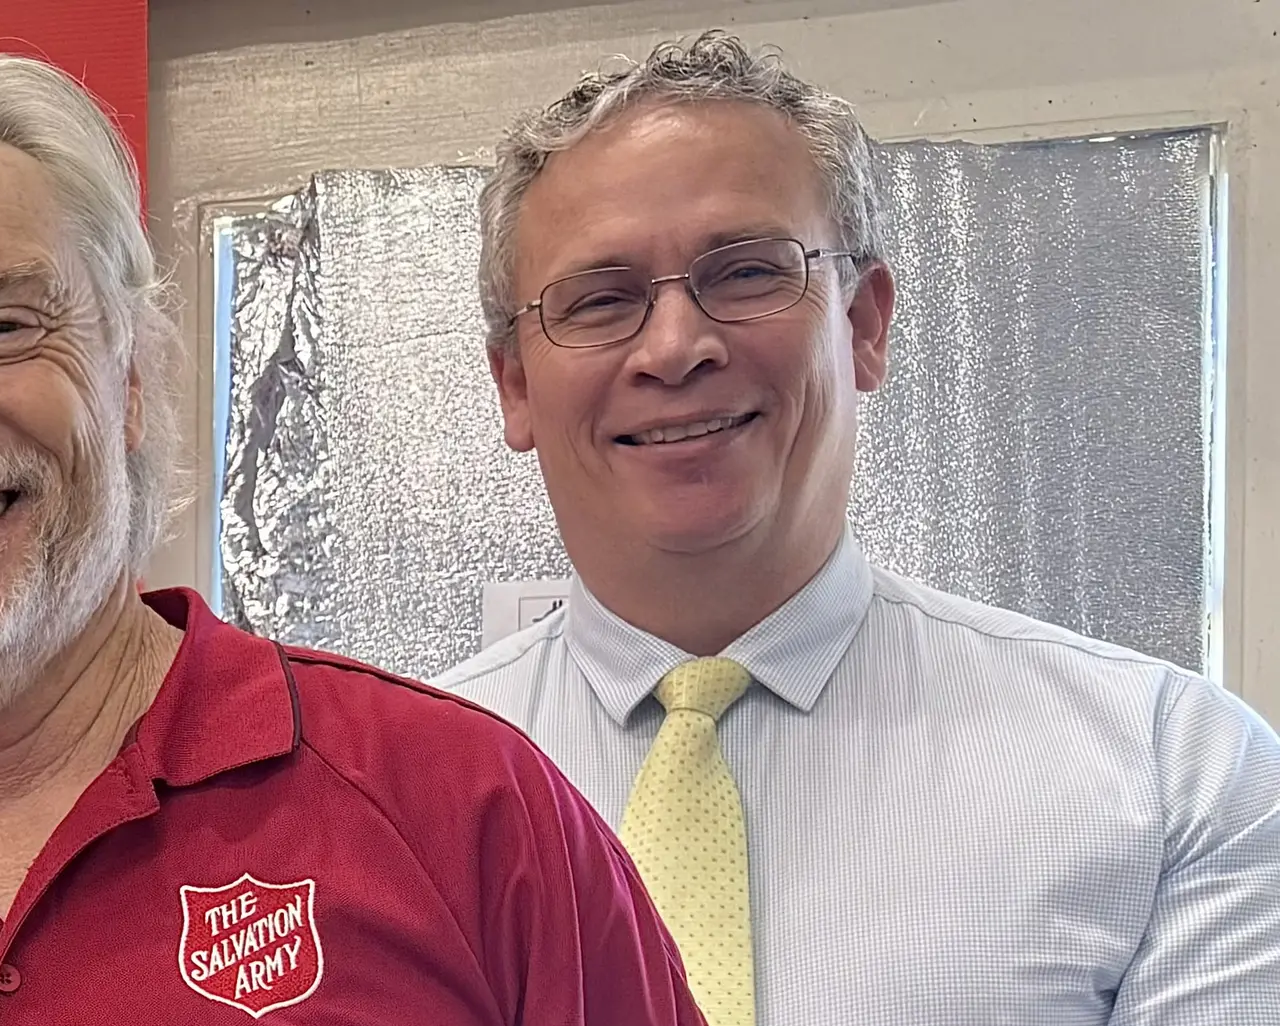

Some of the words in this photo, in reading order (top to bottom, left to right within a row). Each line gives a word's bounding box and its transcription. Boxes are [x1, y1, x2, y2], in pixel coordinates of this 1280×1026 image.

[191, 894, 303, 981] SALVATION
[205, 891, 257, 936] THE
[235, 935, 301, 1000] ARMY
